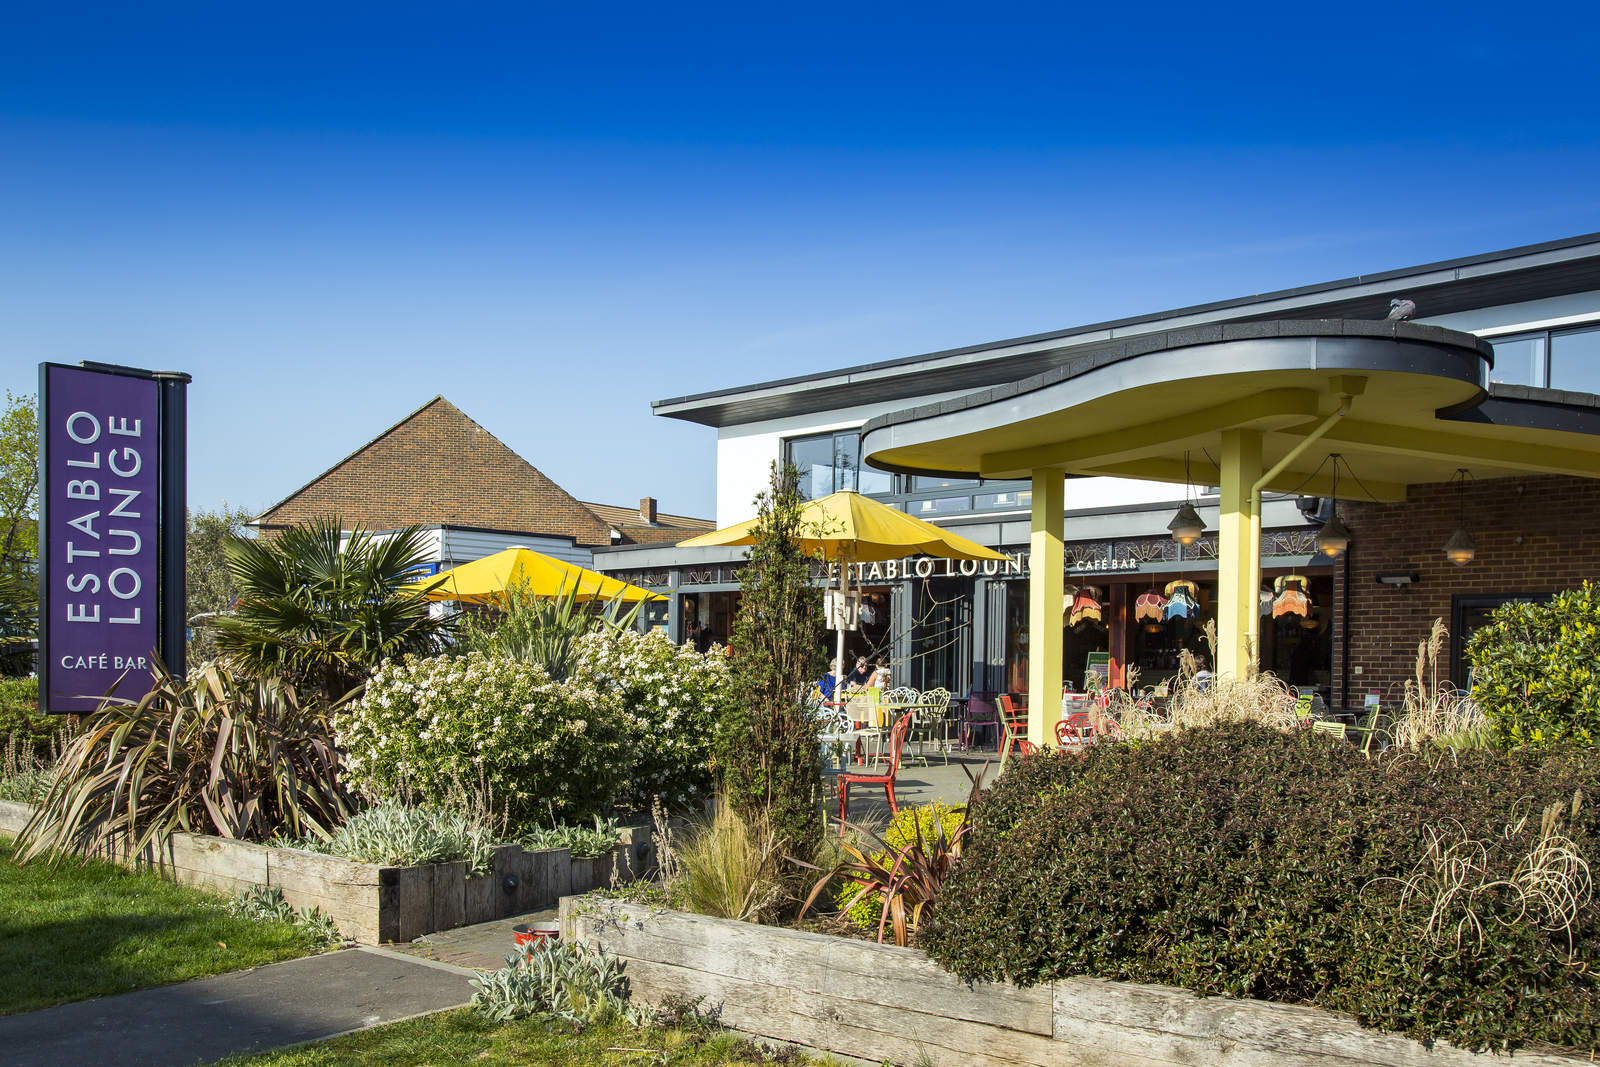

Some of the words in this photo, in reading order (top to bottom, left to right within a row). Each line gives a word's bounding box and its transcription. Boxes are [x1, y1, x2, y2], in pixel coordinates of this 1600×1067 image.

[66, 411, 101, 623] ESTABLO
[108, 415, 142, 625] LOUNGE
[946, 552, 1032, 577] LOUN
[1076, 557, 1108, 571] CAFÉ
[1112, 558, 1137, 570] BAR
[61, 653, 108, 670] CAFÉ
[114, 656, 147, 670] BAR
